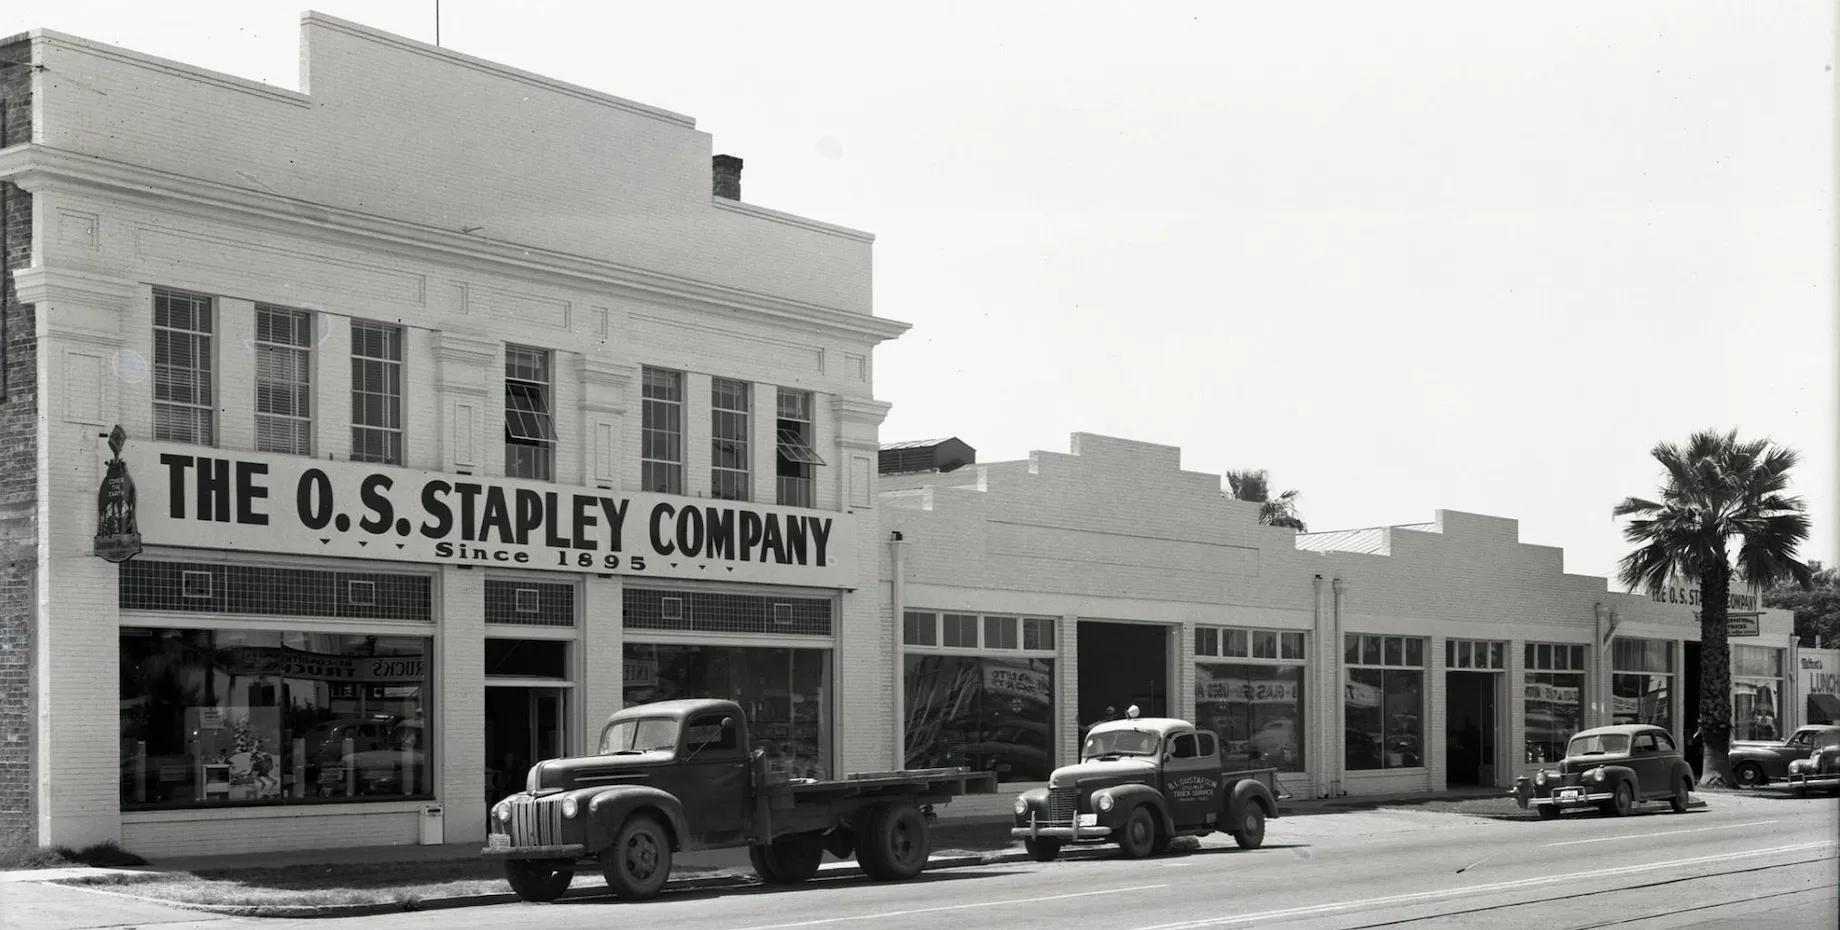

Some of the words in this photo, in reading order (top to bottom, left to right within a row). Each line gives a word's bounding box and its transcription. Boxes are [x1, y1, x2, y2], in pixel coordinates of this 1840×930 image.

[160, 453, 269, 526] THE
[420, 480, 629, 552] STAPLEY
[649, 503, 832, 567] COMPANY
[435, 542, 530, 563] Since
[558, 551, 647, 570] 1895
[1810, 672, 1840, 693] LUNCH
